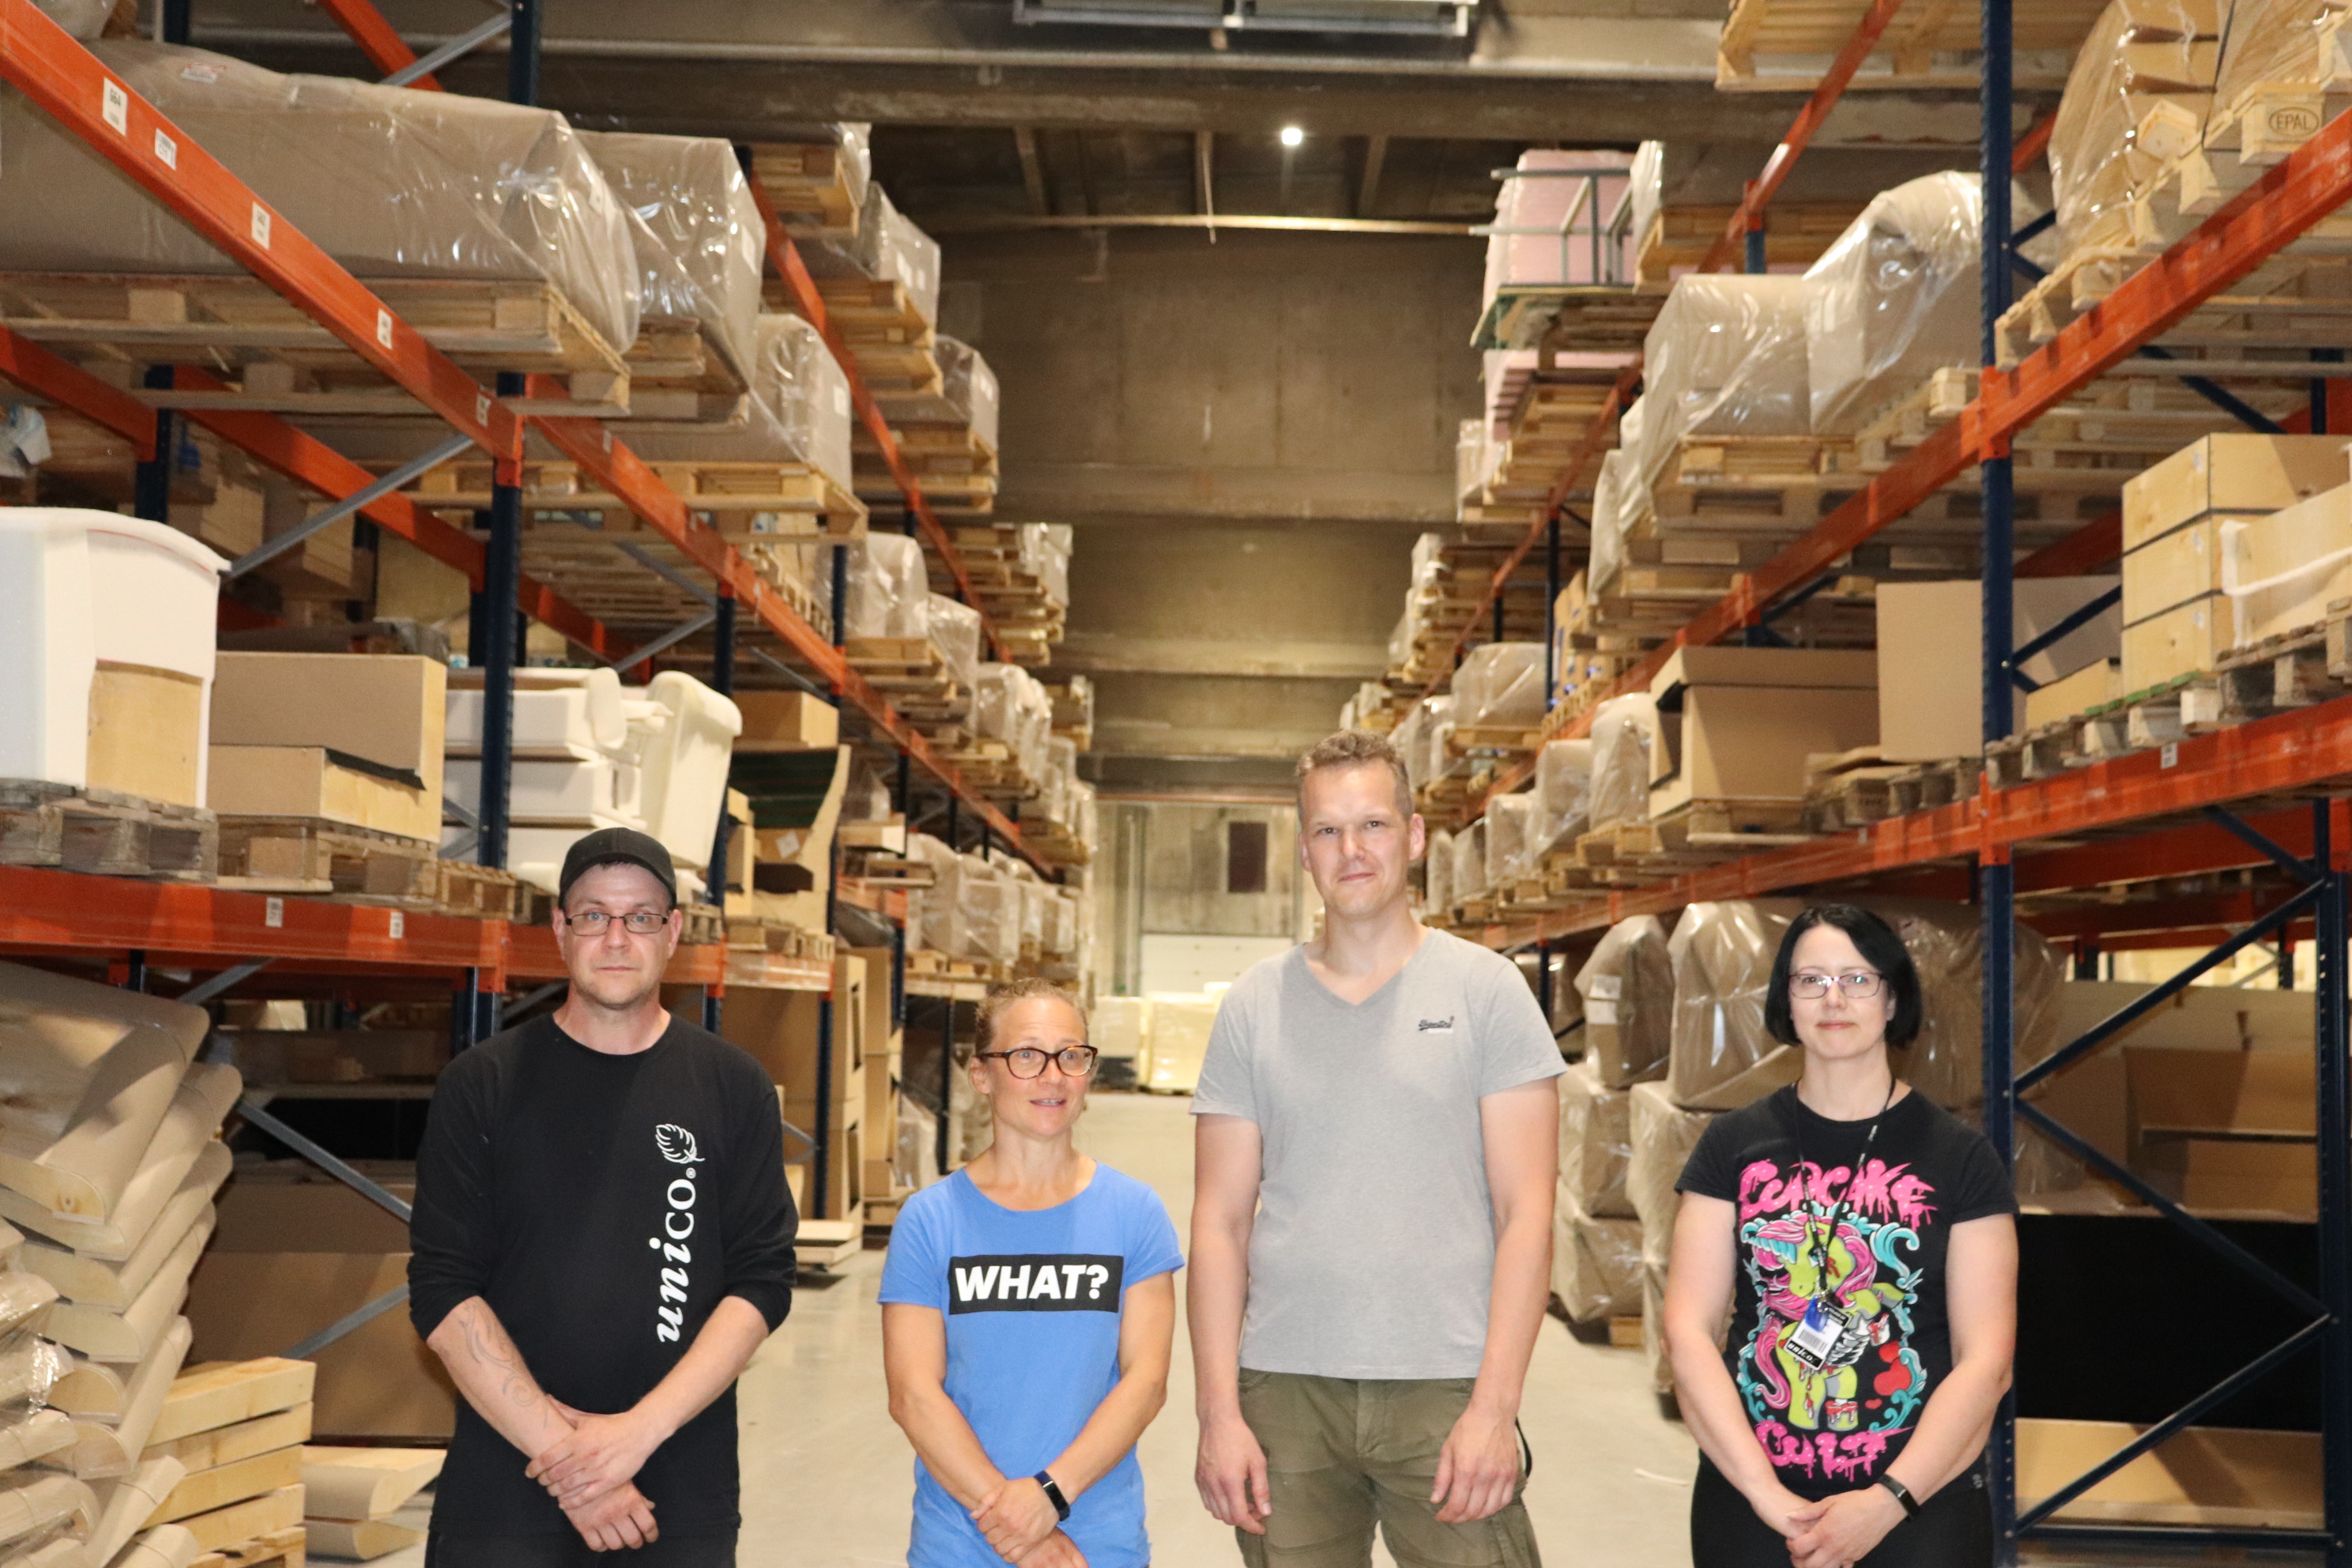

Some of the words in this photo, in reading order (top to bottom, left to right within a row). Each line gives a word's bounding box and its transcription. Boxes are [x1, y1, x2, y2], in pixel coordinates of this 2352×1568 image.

[2277, 113, 2312, 132] EPAL
[955, 1265, 1109, 1302] WHAT?
[1787, 1343, 1813, 1361] unico
